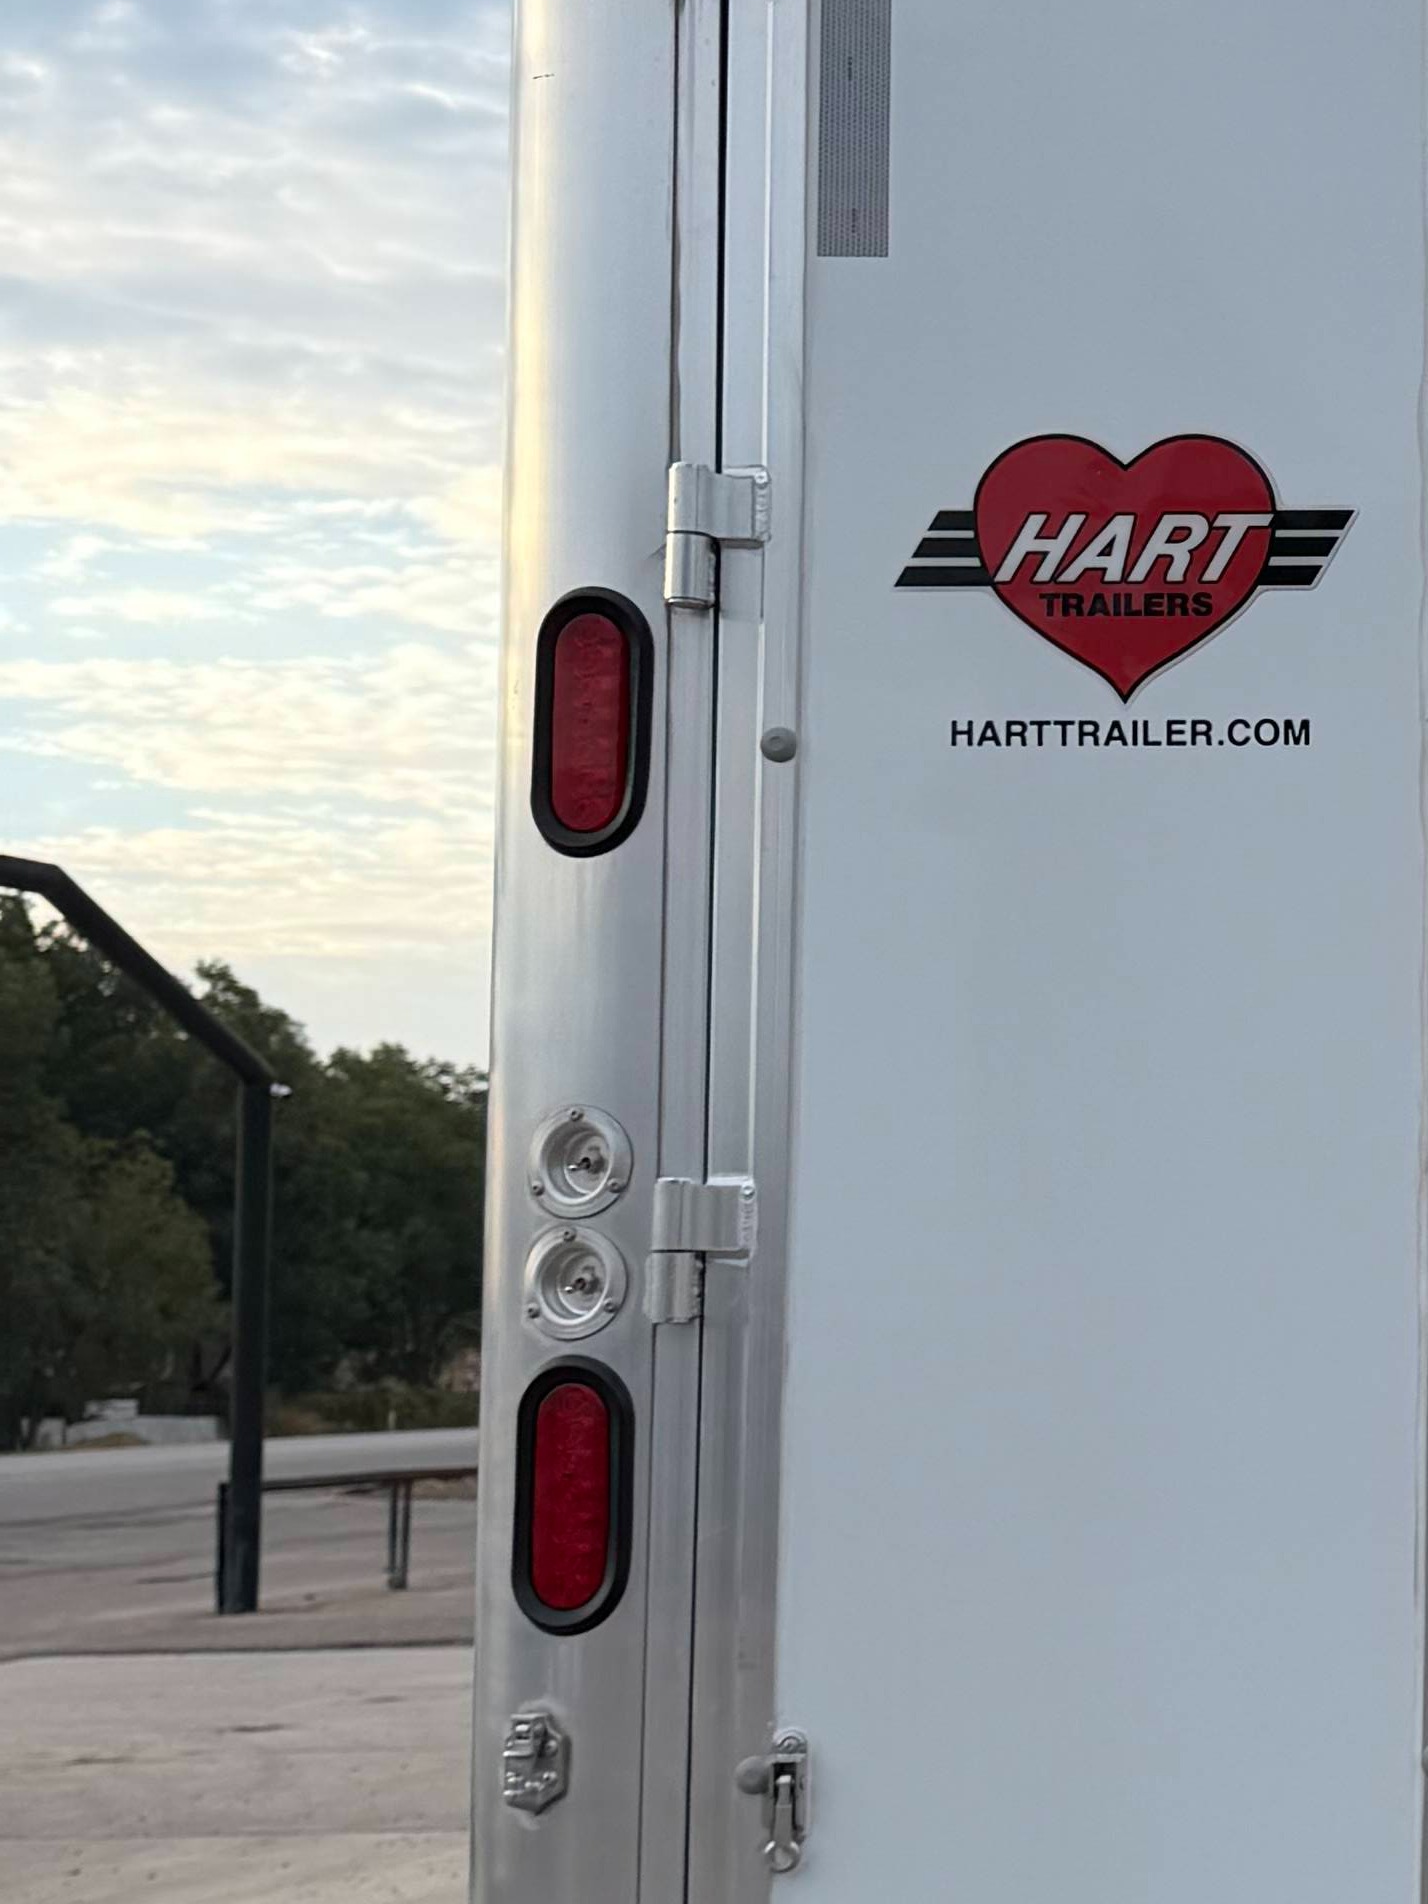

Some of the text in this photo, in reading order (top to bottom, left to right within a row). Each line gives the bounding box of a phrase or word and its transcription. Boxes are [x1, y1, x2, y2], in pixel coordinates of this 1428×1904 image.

[993, 511, 1275, 585] HART
[1039, 592, 1213, 617] TRAILERS
[950, 718, 1311, 747] HARTTRAILER.COM
